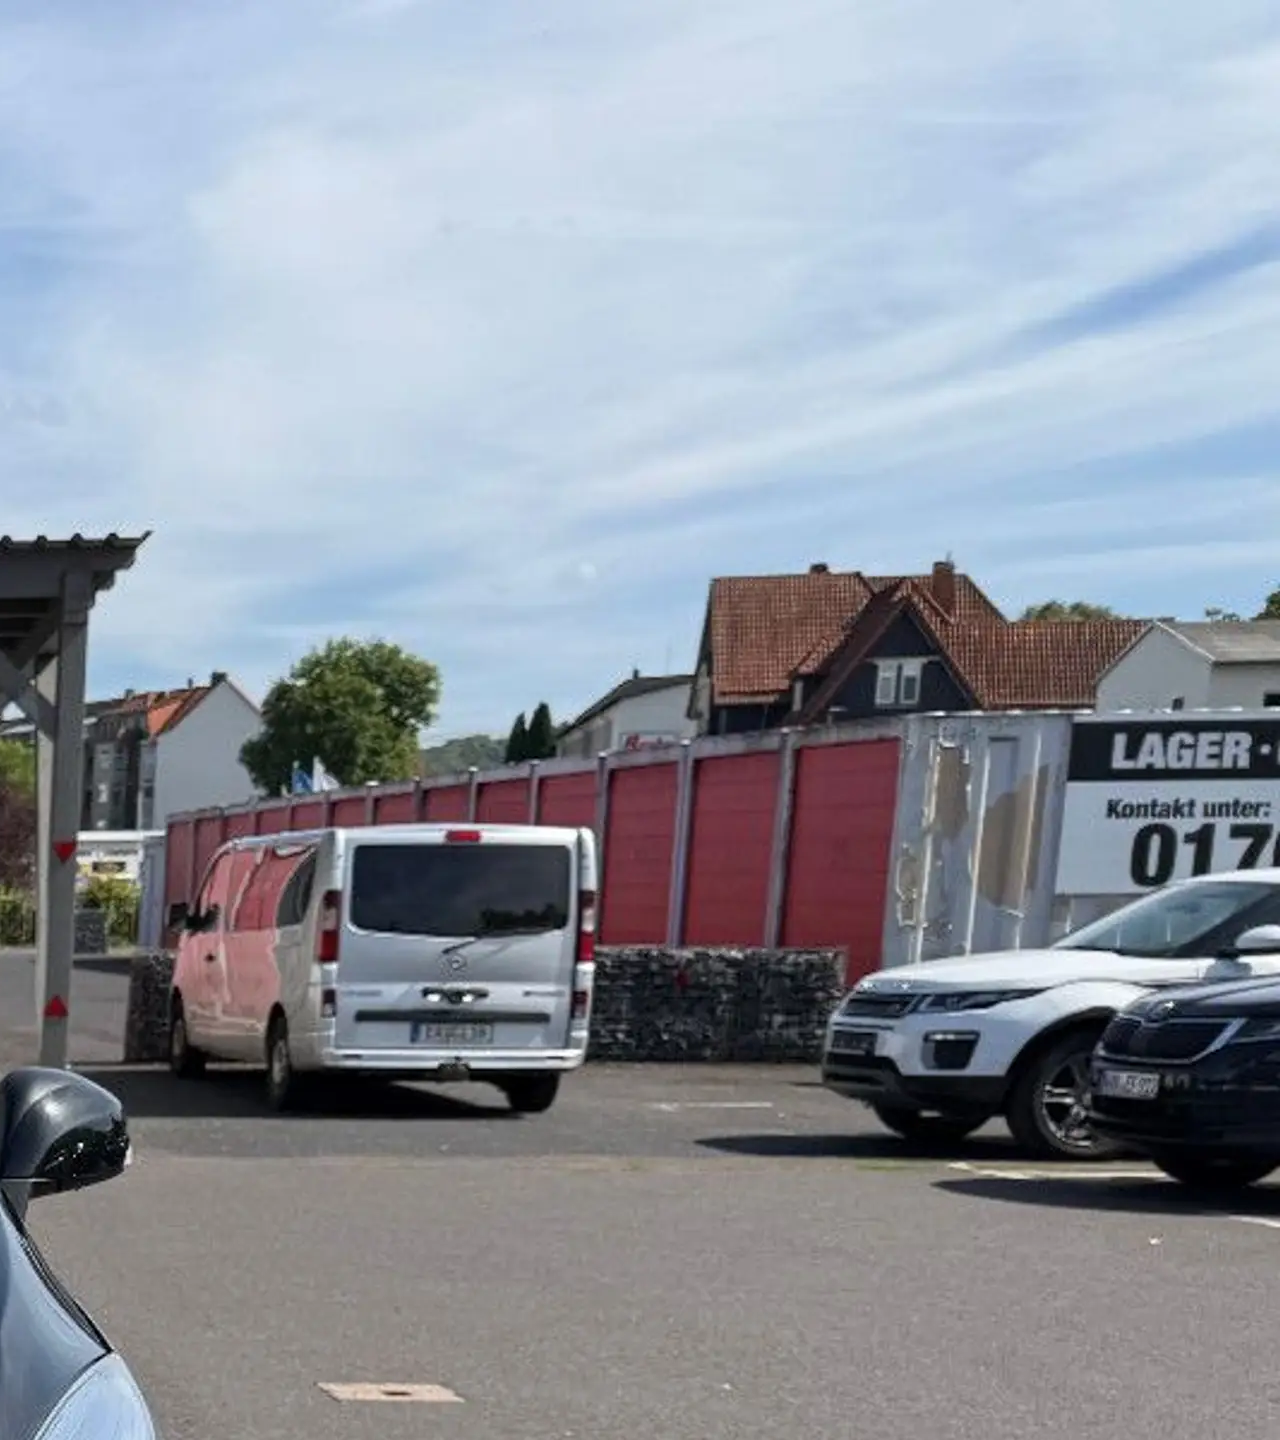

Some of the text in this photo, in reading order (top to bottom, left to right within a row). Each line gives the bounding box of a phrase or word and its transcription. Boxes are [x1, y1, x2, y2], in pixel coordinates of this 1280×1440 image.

[1111, 732, 1252, 769] LAGER
[1106, 798, 1271, 819] Kontakt unter:
[1130, 823, 1280, 887] 017
